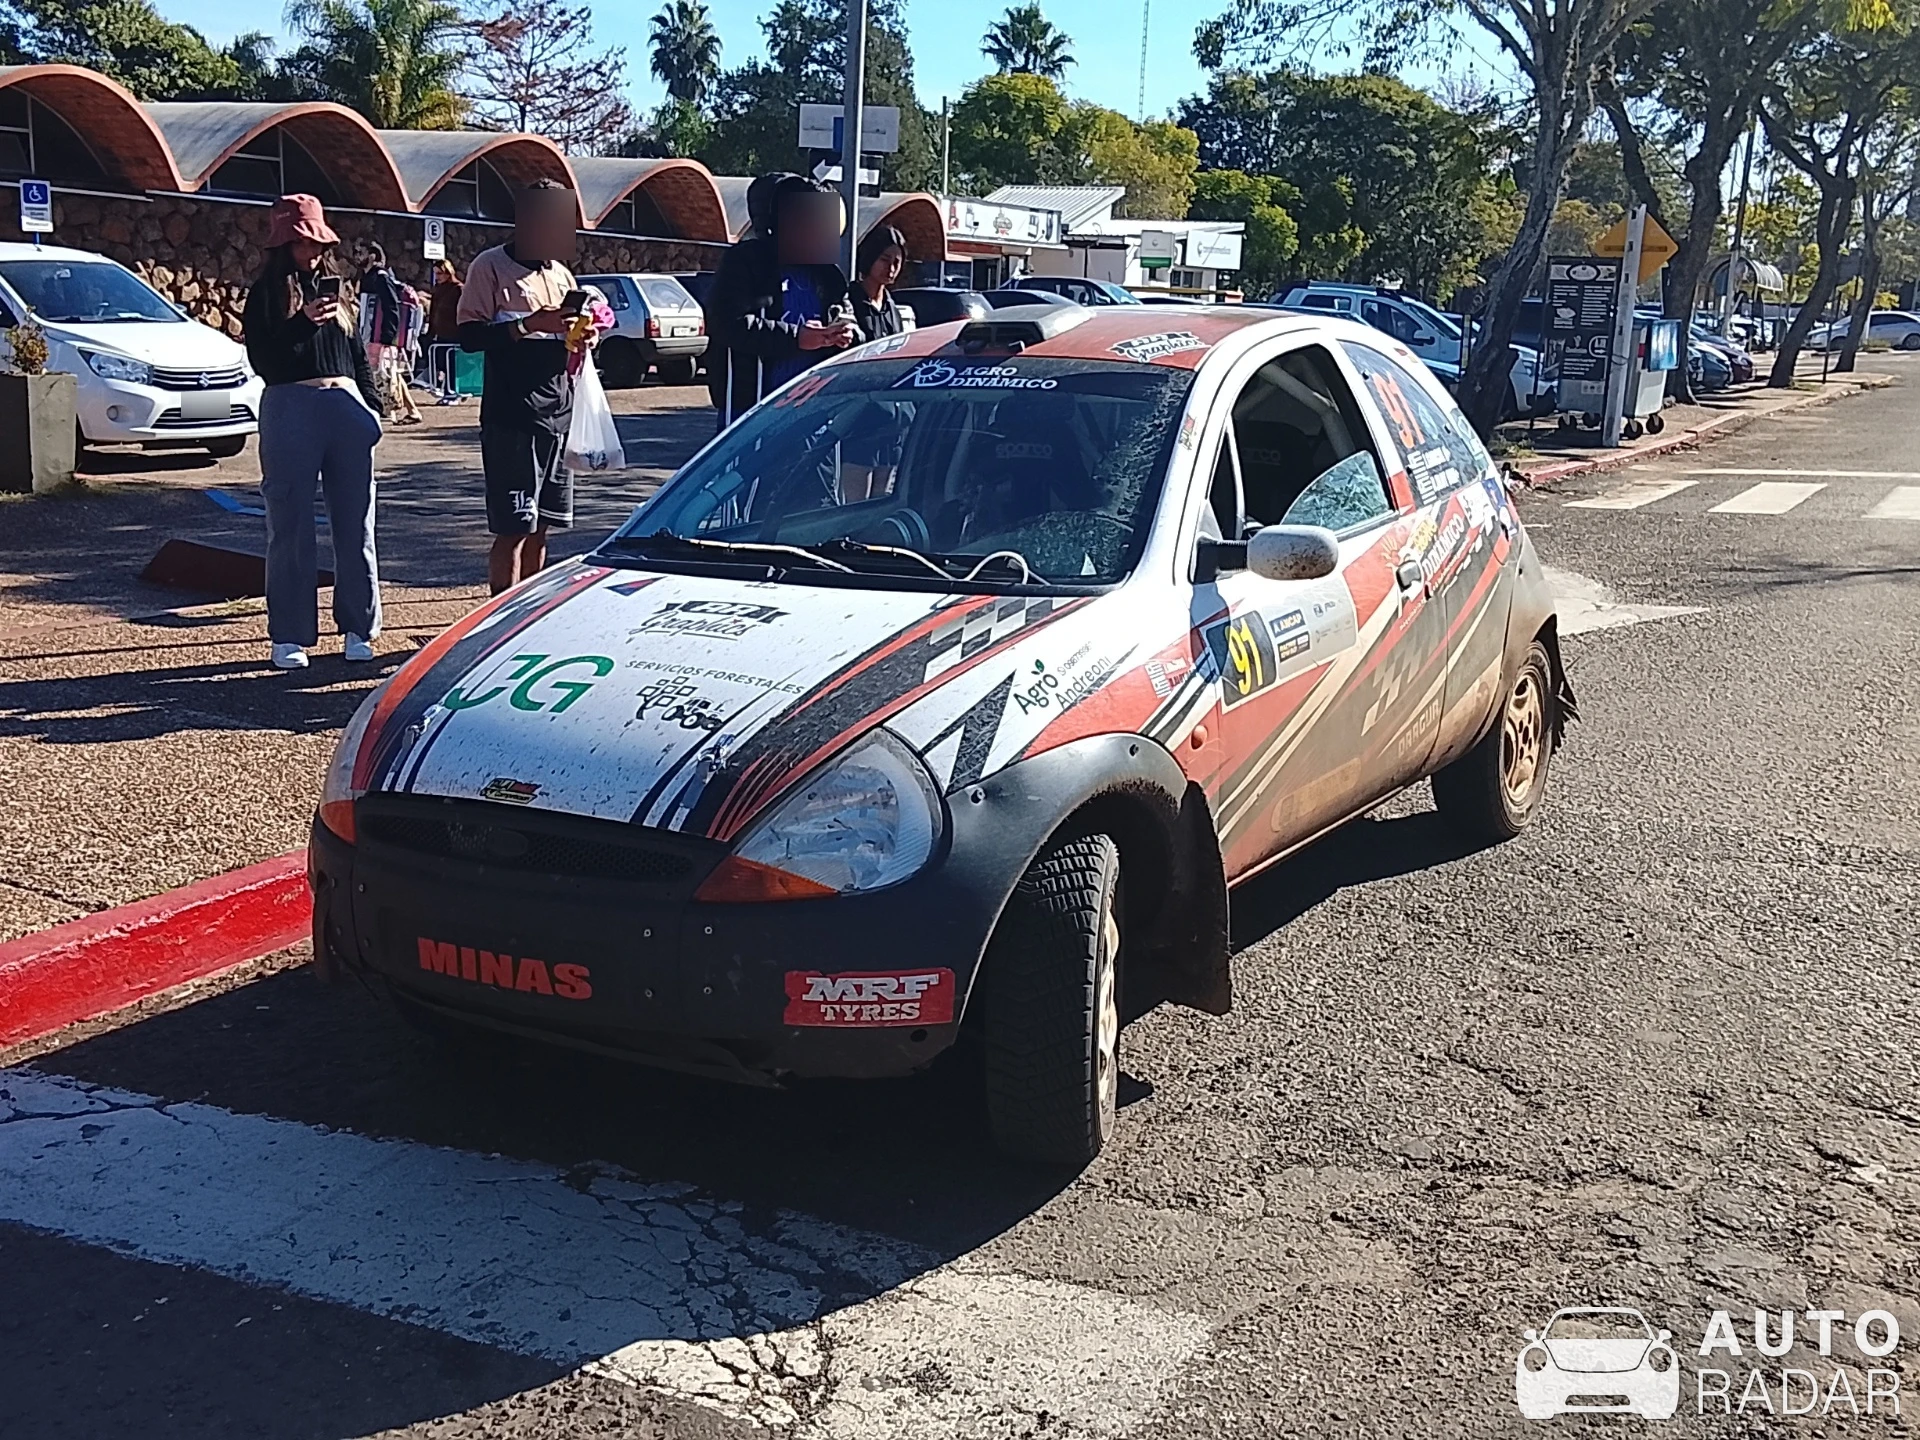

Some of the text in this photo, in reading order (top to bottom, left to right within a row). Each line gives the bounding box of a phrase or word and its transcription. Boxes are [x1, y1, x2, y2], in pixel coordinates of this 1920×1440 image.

[958, 366, 1017, 377] AGRO
[774, 372, 839, 408] 91
[1371, 370, 1426, 449] 91
[628, 611, 758, 637] Graphics
[1225, 617, 1264, 696] 91
[625, 660, 806, 695] SERVICIOS FORESTALES
[1013, 673, 1059, 716] Agro
[1055, 656, 1112, 709] Andreoni
[417, 936, 593, 1000] MINAS
[802, 973, 939, 1002] MRF
[821, 1002, 920, 1021] TYRES
